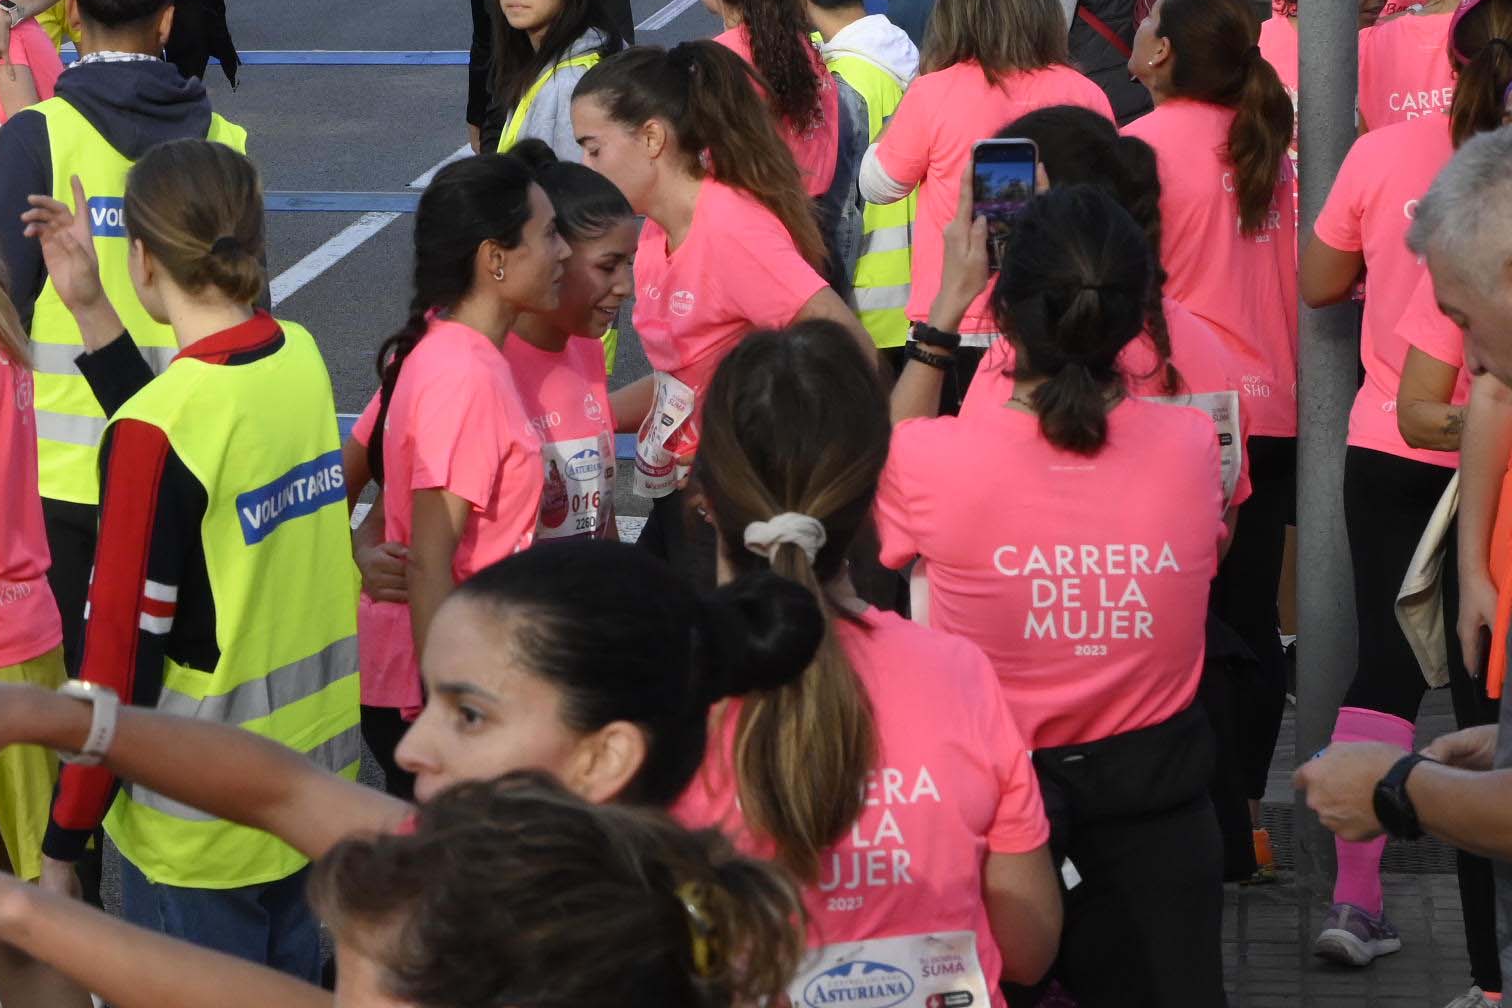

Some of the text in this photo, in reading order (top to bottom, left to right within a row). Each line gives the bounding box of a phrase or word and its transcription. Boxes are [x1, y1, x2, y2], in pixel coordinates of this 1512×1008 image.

[1389, 87, 1454, 112] CARRE
[242, 463, 344, 529] VOLUNTARIS
[572, 491, 601, 513] 016
[992, 542, 1181, 577] CARRERA
[1031, 578, 1148, 608] DE LA
[1024, 609, 1154, 640] MUJER
[1074, 644, 1108, 657] 2023
[852, 810, 904, 848] LA
[819, 850, 913, 892] UJER
[922, 962, 965, 978] SUMA
[814, 981, 906, 1005] ASTURIANA
